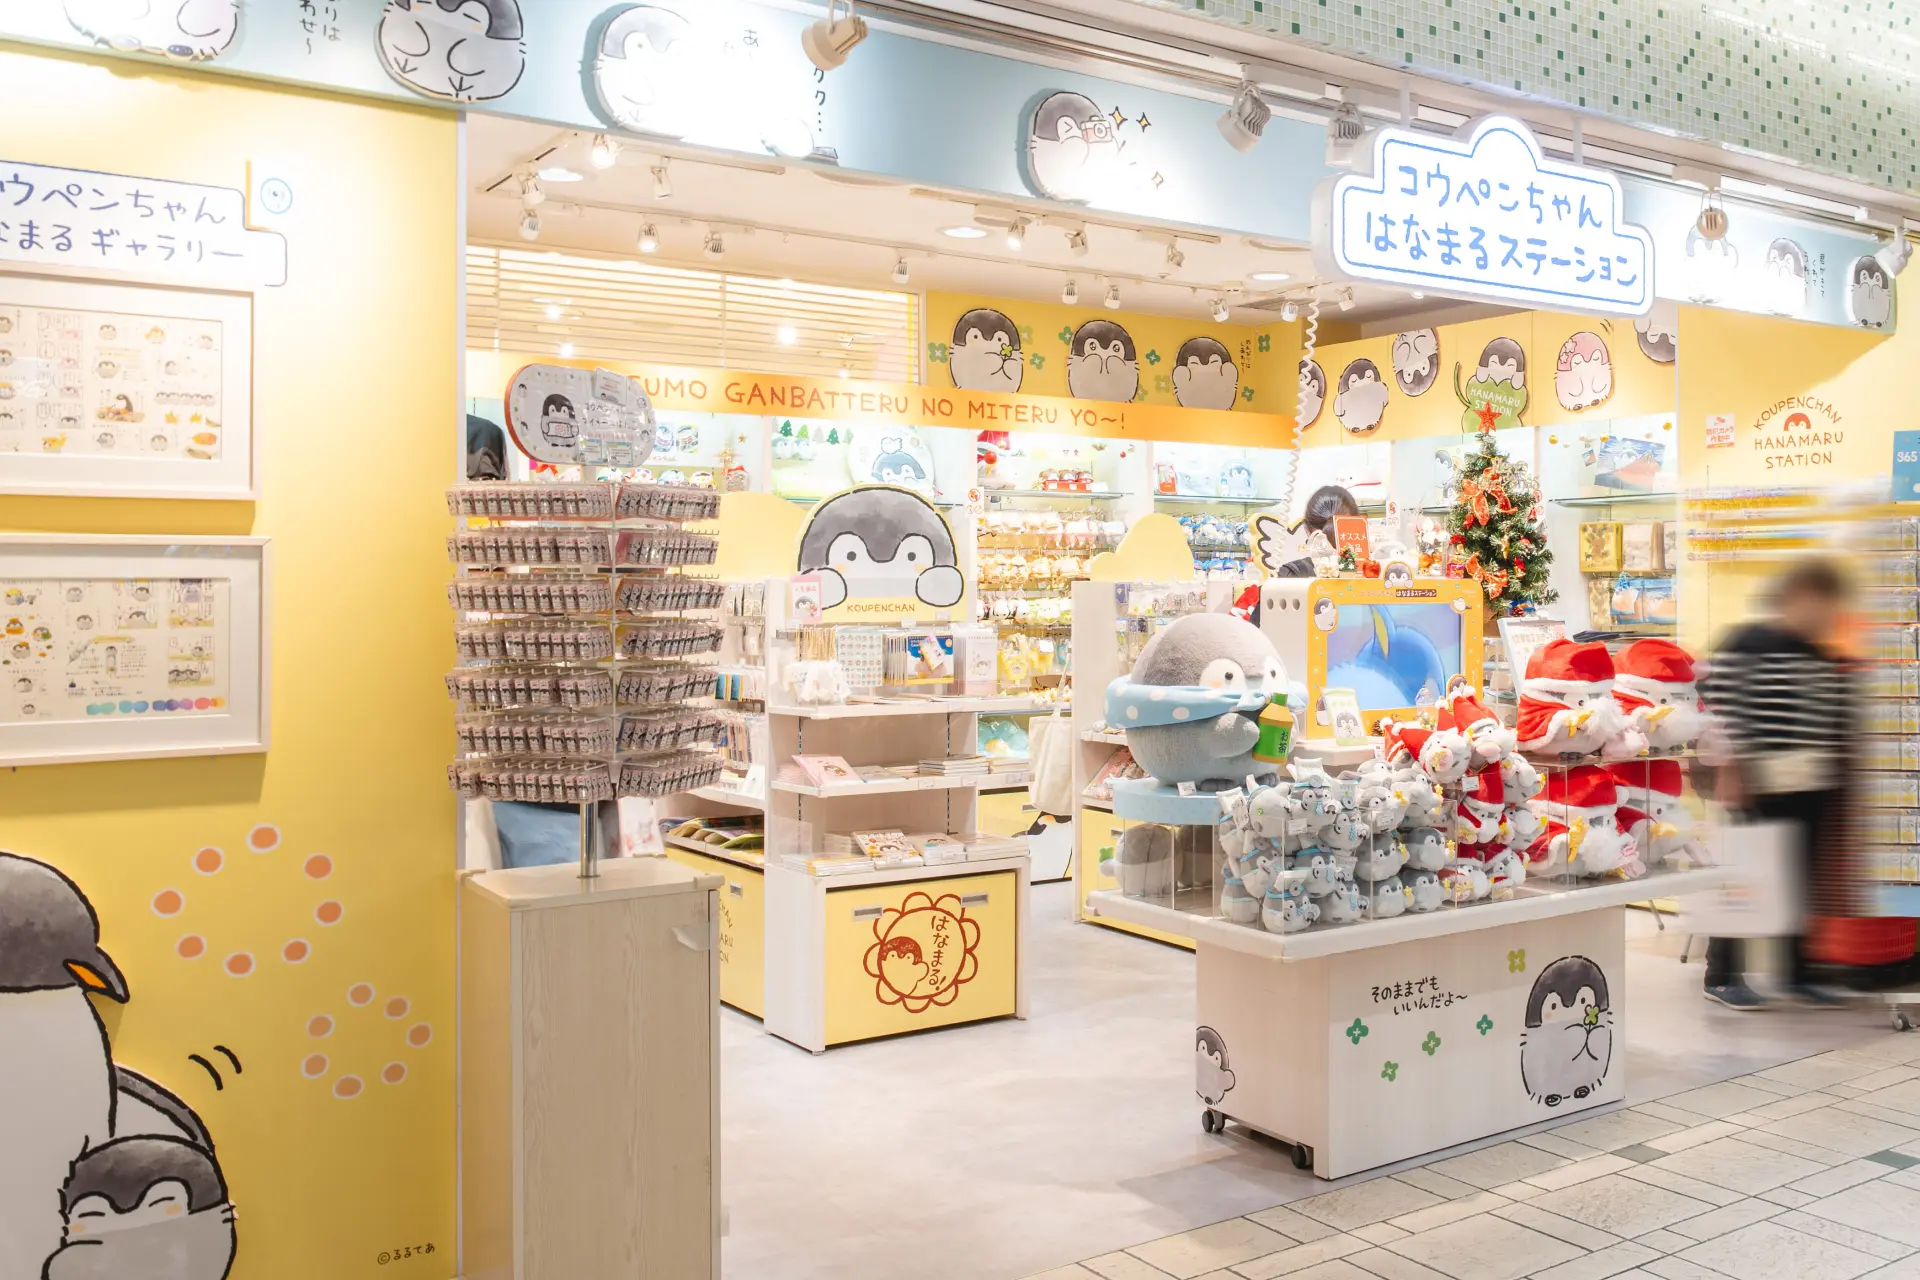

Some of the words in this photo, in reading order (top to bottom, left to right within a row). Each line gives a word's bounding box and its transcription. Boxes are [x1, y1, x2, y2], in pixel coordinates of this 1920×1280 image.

[1398, 163, 1602, 228] コウペンちゃん
[1366, 211, 1637, 286] はなまるステーション
[628, 375, 708, 400] UMO
[724, 382, 909, 414] GANBATTERU
[922, 398, 953, 417] NO
[968, 400, 1057, 424] MITERU
[1470, 387, 1520, 408] HANAMARU
[1753, 396, 1843, 431] KOUPENCHAN
[1754, 431, 1844, 451] HANAMARU
[1764, 451, 1833, 470] STATION
[1339, 532, 1367, 541] オススメ
[846, 603, 916, 613] KOUPENCHAN
[1278, 731, 1289, 754] お茶
[1371, 975, 1440, 1004] そのままでも
